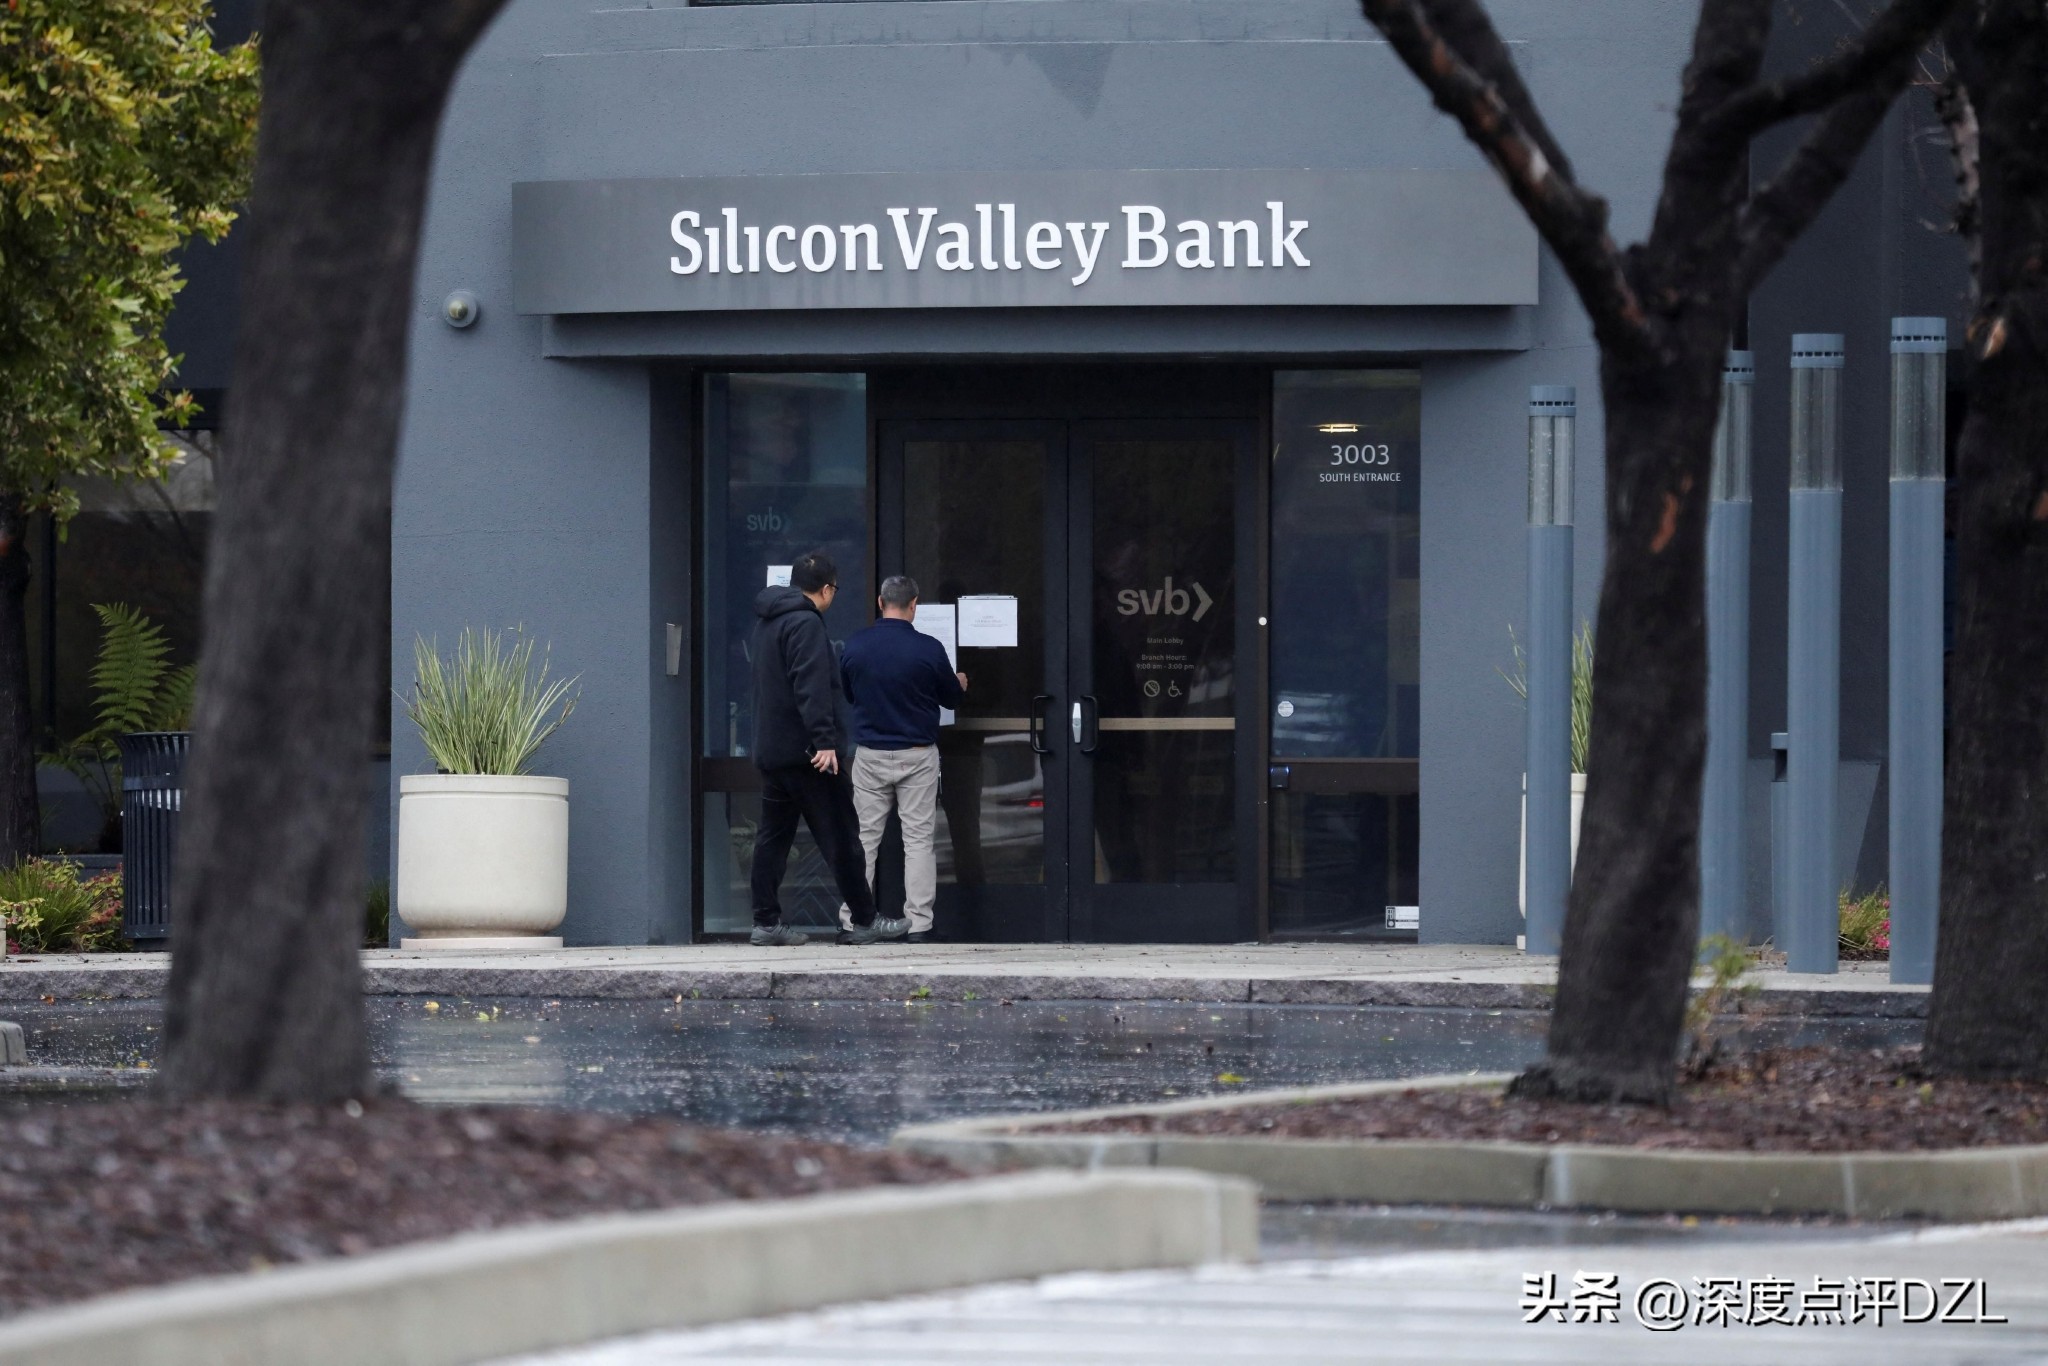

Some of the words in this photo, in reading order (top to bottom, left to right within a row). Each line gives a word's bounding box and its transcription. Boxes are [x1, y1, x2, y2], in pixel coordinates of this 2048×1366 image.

[670, 206, 882, 275] Silicon
[887, 203, 1110, 286] Valley
[1121, 201, 1311, 270] Bank
[1330, 444, 1390, 466] 3003
[1319, 473, 1351, 482] SOUTH
[1353, 472, 1401, 482] ENTRANCE
[746, 506, 782, 532] svb
[1116, 576, 1191, 616] svb
[1164, 637, 1184, 646] Lobby
